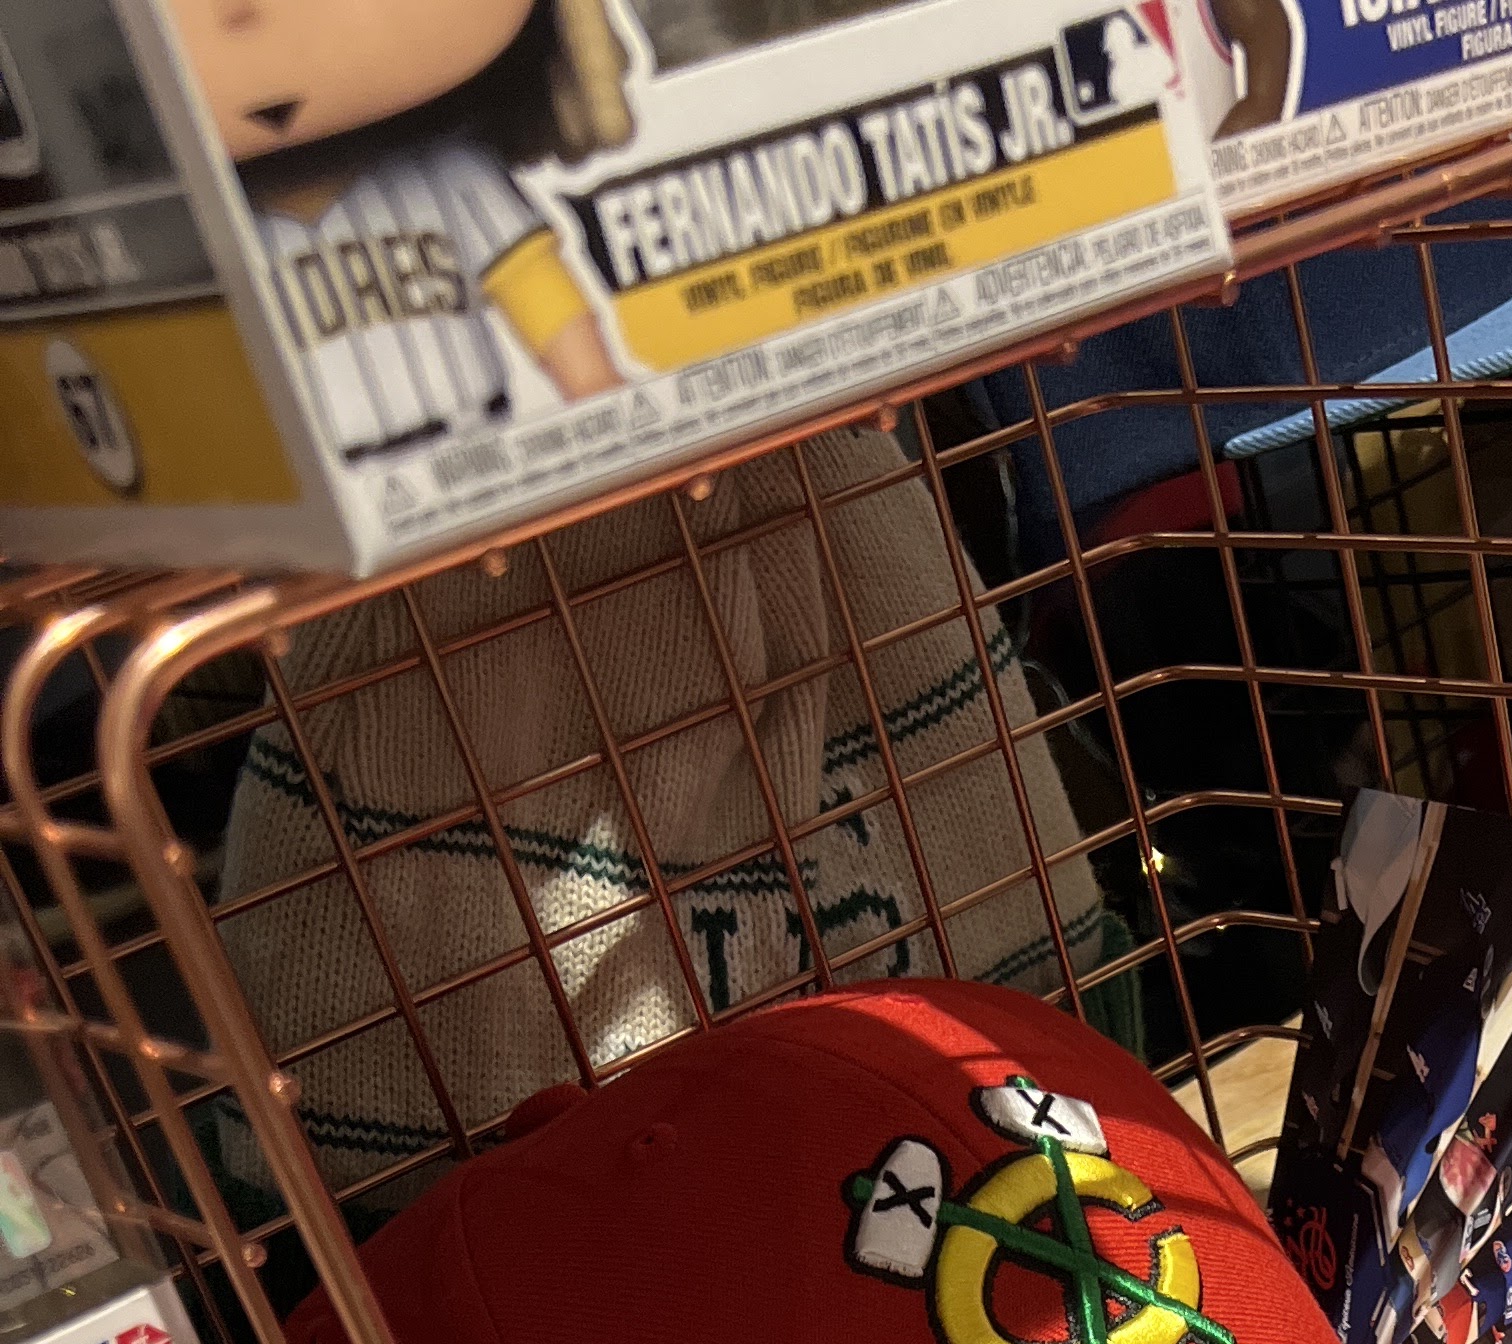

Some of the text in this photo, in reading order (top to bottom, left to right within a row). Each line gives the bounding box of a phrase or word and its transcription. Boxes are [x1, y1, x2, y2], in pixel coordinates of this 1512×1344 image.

[1387, 14, 1434, 52] VINYL
[596, 121, 869, 287] FERNANDO
[1000, 63, 1075, 163] JR.
